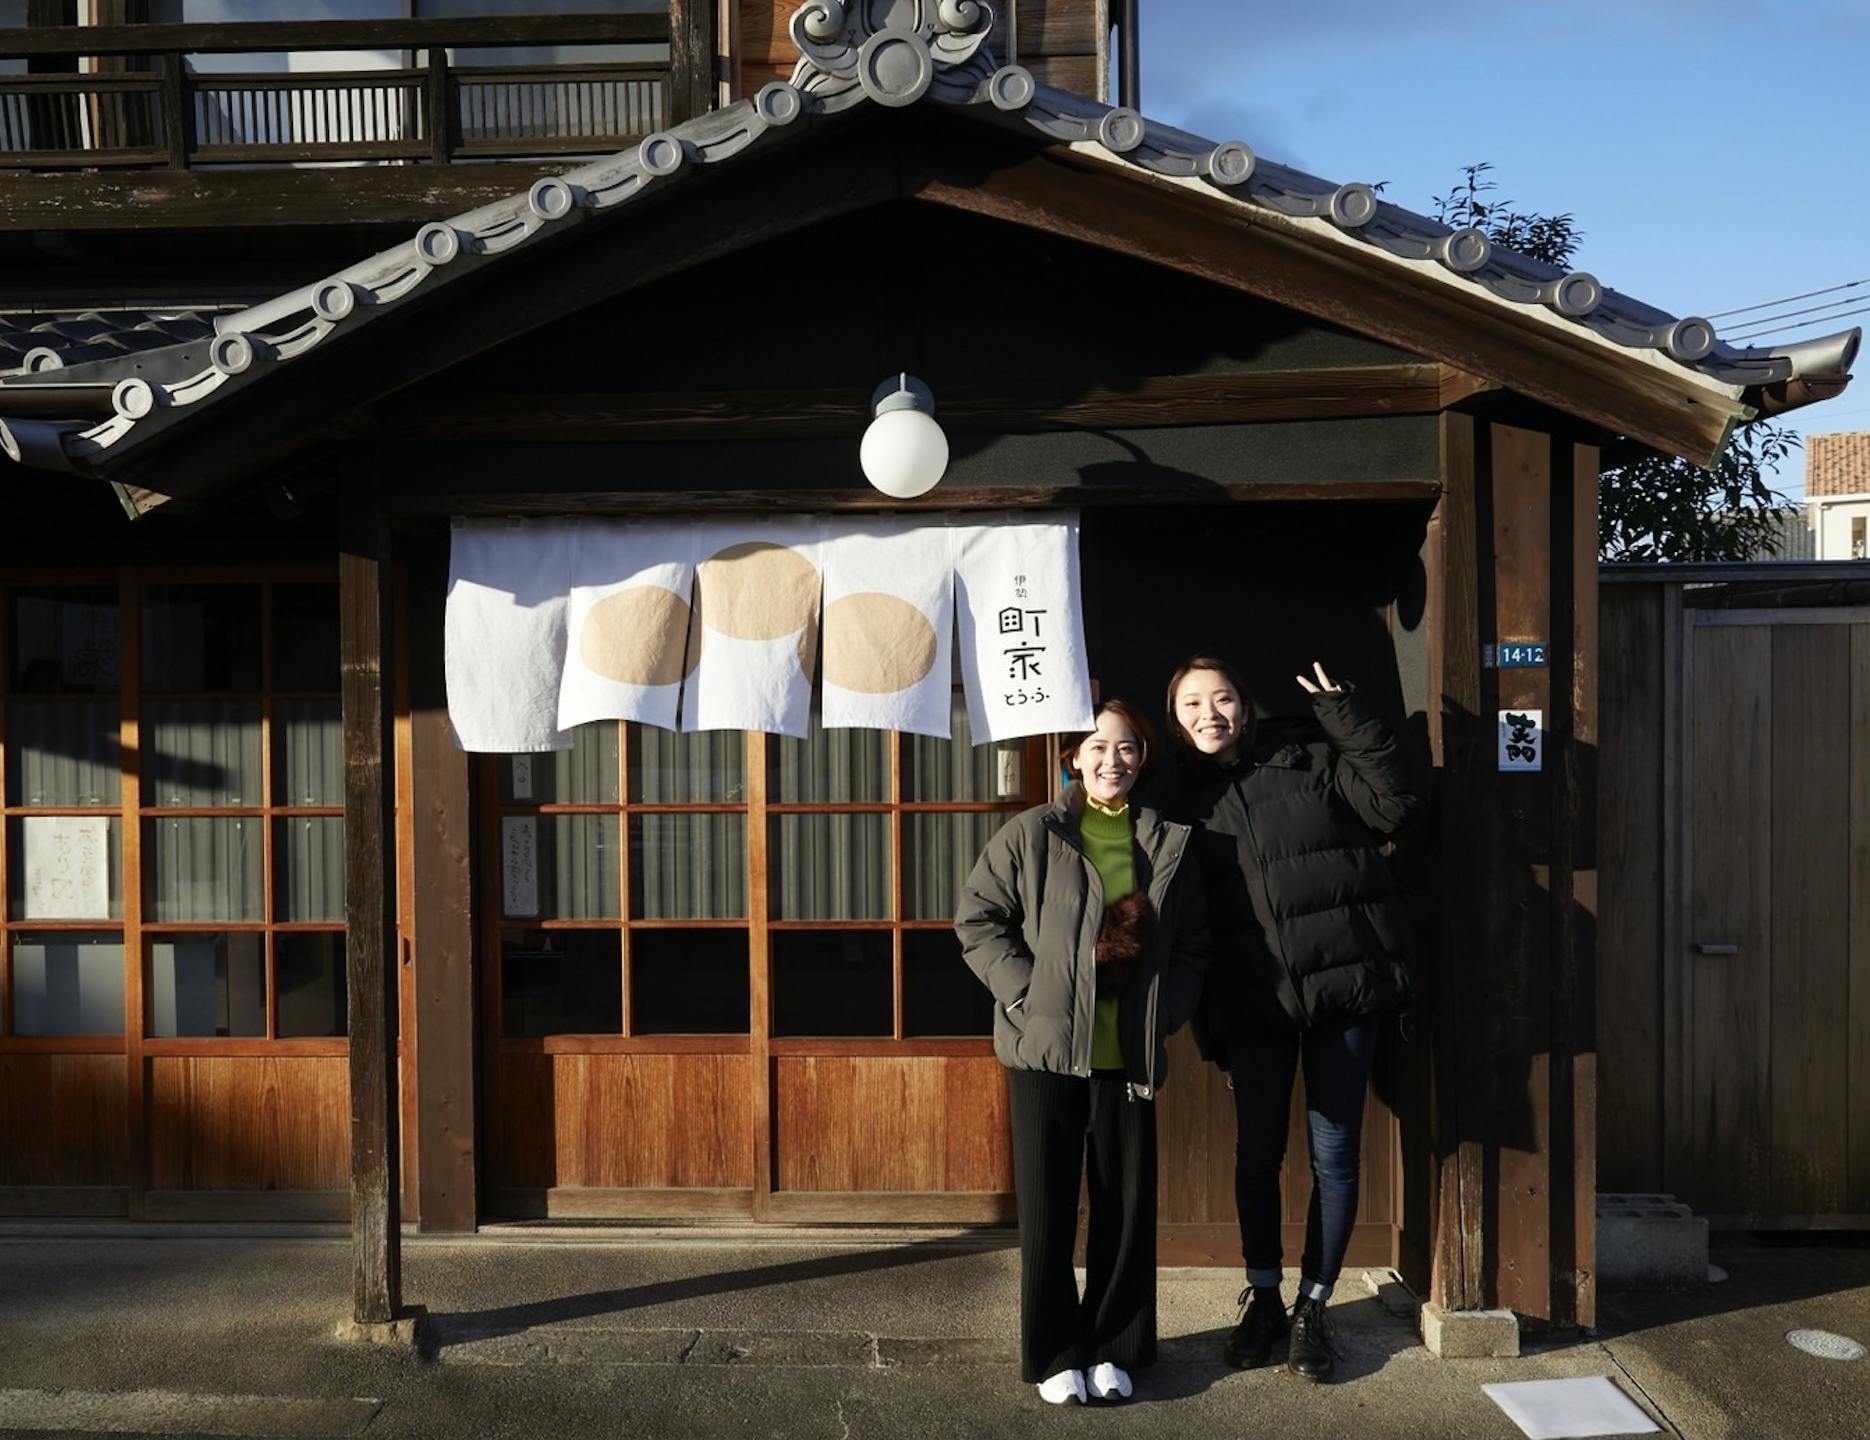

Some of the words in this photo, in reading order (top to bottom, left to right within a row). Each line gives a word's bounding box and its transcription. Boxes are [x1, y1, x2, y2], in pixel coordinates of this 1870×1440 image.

[999, 606, 1047, 680] 町家
[1004, 685, 1050, 706] とうふ
